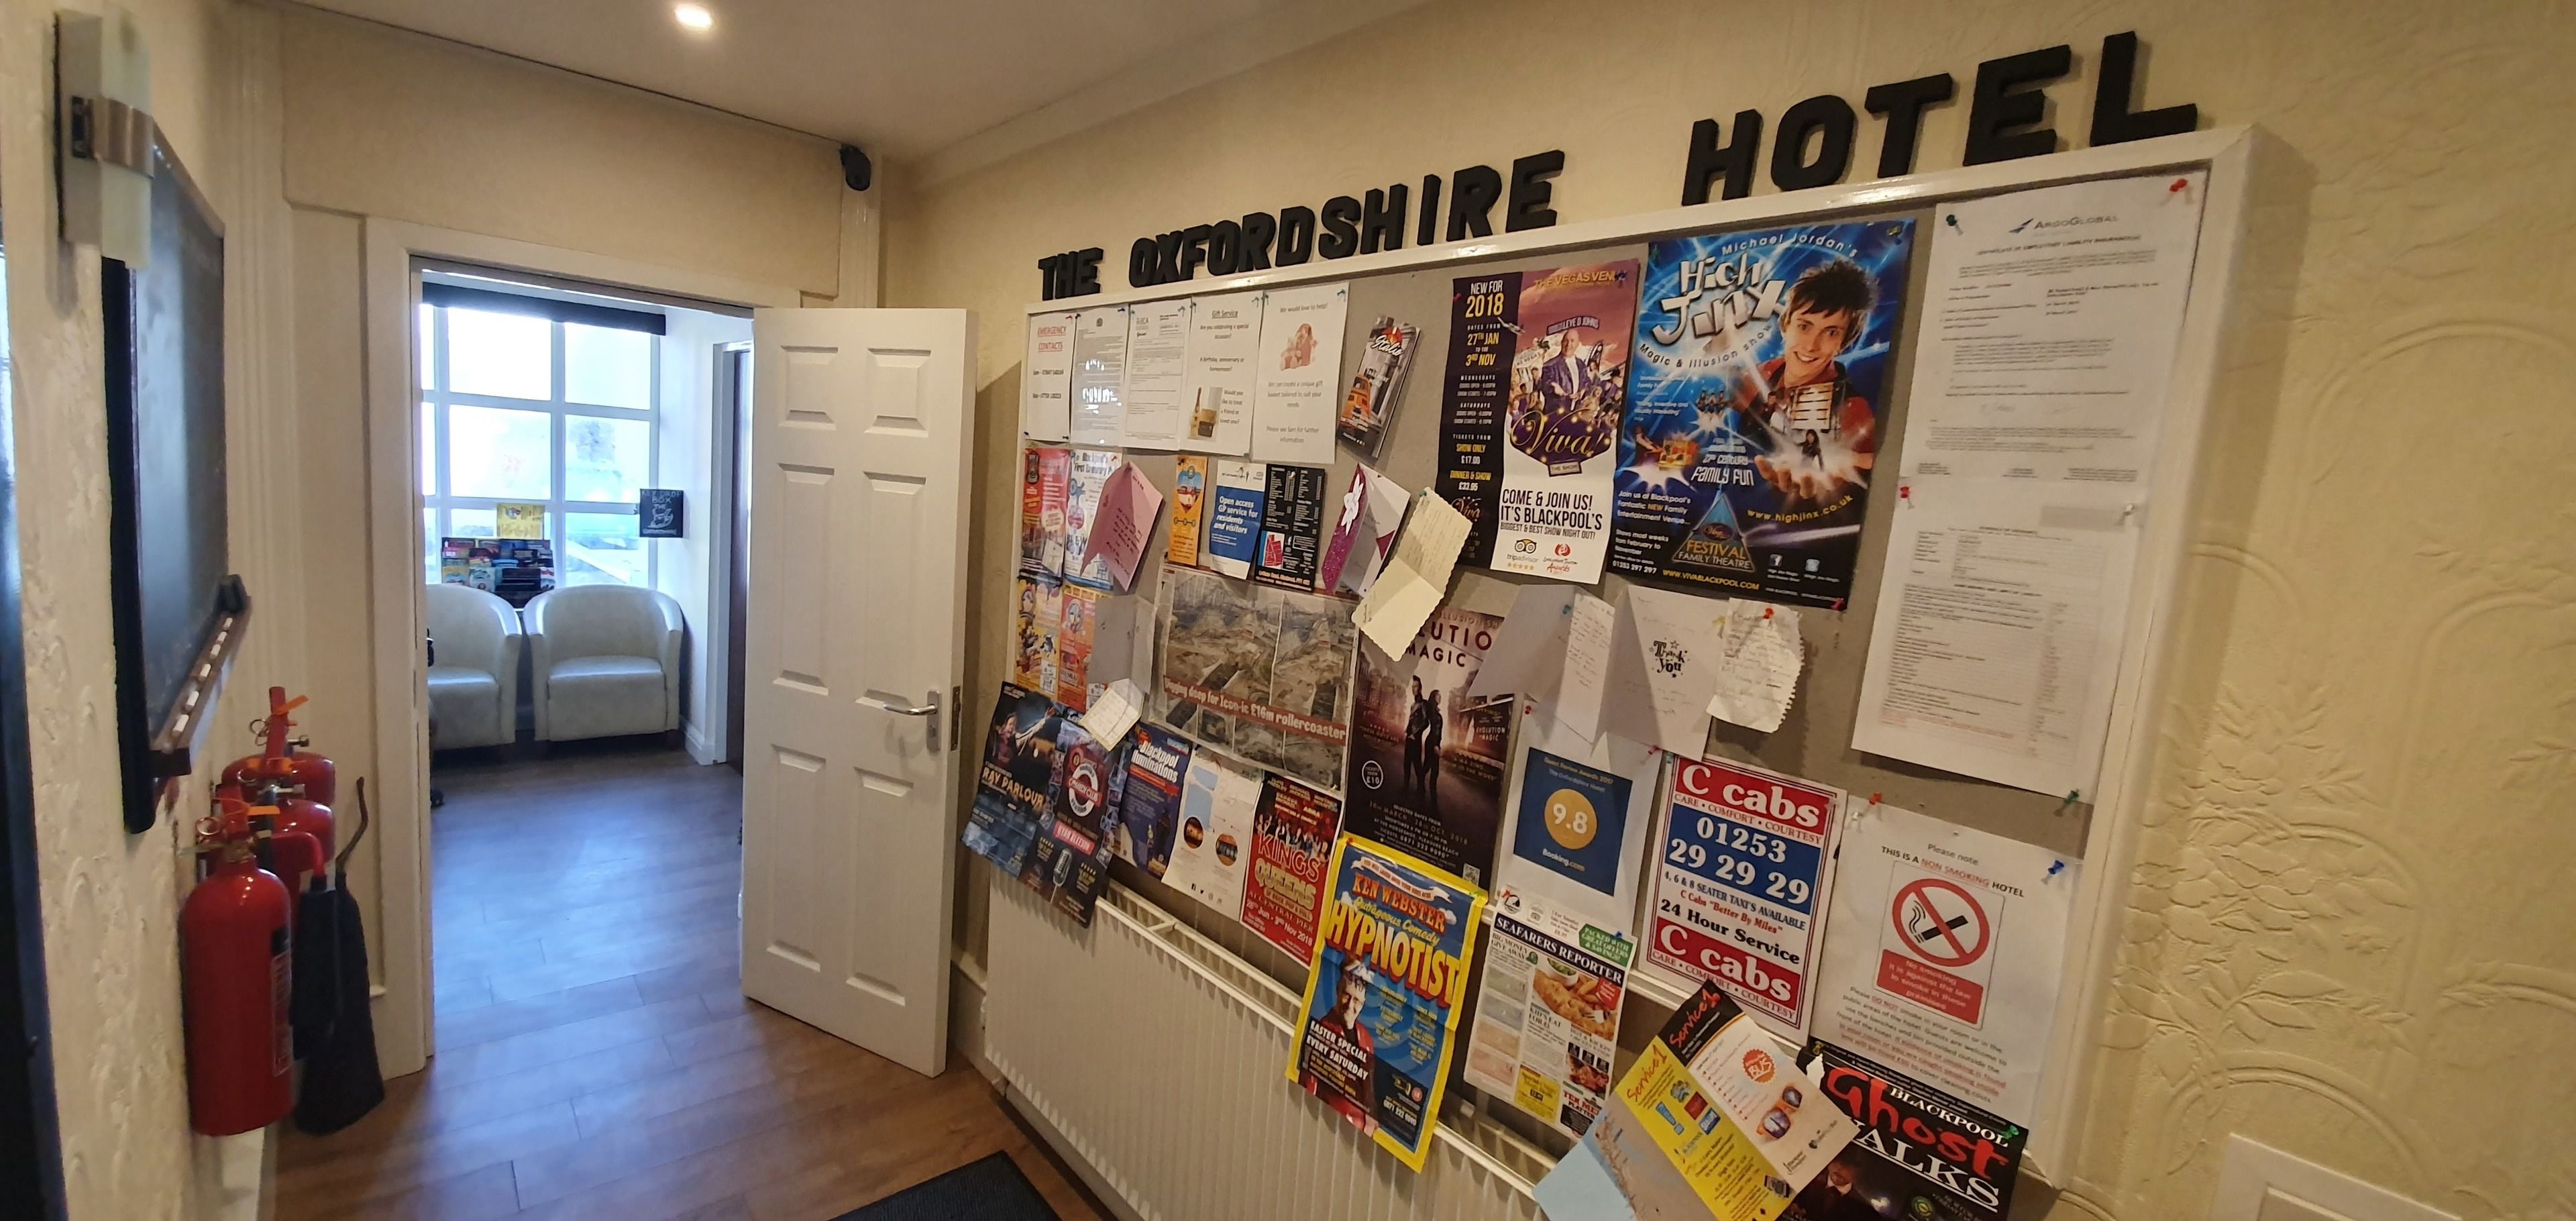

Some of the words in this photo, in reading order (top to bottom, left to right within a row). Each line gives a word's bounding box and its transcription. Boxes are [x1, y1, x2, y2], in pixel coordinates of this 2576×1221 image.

[1038, 247, 1104, 301] THE
[1128, 150, 1566, 288] OXFORDSHIRE
[1681, 30, 2198, 206] HOTEL
[1721, 234, 1783, 256] Michael
[1791, 232, 1859, 258] Jordan's
[1470, 282, 1488, 295] NEW
[1489, 280, 1503, 293] FOR
[1554, 274, 1593, 286] VEGAS
[1465, 293, 1505, 318] 2018
[1484, 332, 1499, 345] JAN
[1478, 354, 1496, 366] NOV
[1639, 343, 1671, 368] Magic
[1219, 496, 1234, 506] Open
[1235, 500, 1254, 509] access
[1227, 507, 1248, 517] service
[1248, 509, 1258, 518] for
[1502, 488, 1533, 505] COME
[1536, 492, 1544, 506] &
[1545, 492, 1571, 509] JOIN
[1572, 494, 1593, 511] US!
[1213, 522, 1225, 530] and
[1225, 523, 1248, 534] visitors
[1216, 514, 1244, 525] residents
[1500, 522, 1523, 533] BIGGEST
[1529, 525, 1543, 535] BEST
[1544, 527, 1562, 536] SHOW
[1562, 528, 1580, 539] NIGHT
[1501, 505, 1521, 522] IT'S
[1523, 510, 1603, 531] BLACKPOOL'S
[1507, 553, 1539, 563] tripadvisor
[1678, 551, 1709, 564] FAMILY
[1712, 555, 1750, 570] THEATRE
[1686, 540, 1747, 560] FESTIVAL
[1405, 641, 1467, 668] MAGIC
[1189, 686, 1206, 704] deep
[1207, 691, 1219, 705] for
[1250, 702, 1275, 722] £16m
[1275, 712, 1346, 740] rollercoaster
[1139, 740, 1179, 769] Blackpool
[982, 766, 1002, 784] RAY
[1002, 778, 1046, 808] PARLOUR
[1366, 776, 1381, 784] £10
[1682, 763, 1711, 795] C
[1722, 782, 1819, 828] cabs
[1552, 802, 1589, 835] 9.8
[1674, 793, 1699, 807] CARE
[1708, 802, 1755, 825] COMFORT
[1765, 820, 1823, 845] COURTESY
[1696, 816, 1787, 863] 01253
[1927, 843, 1955, 859] Please
[1258, 833, 1321, 883] KINGS
[1542, 848, 1585, 871] Booking.com
[1668, 838, 1707, 869] 29
[1715, 853, 1757, 886] 29
[1765, 871, 1810, 905] 29
[1881, 846, 1900, 859] THIS
[1902, 852, 1911, 861] IS
[1912, 855, 1920, 863] A
[1921, 858, 1943, 871] NON
[1945, 865, 1990, 887] SMOKING
[1992, 882, 2025, 898] HOTEL
[1254, 857, 1317, 910] QUEENS
[1352, 873, 1380, 900] KEN
[1381, 885, 1447, 933] WEBSTER
[1673, 873, 1680, 884] 6
[1680, 876, 1688, 886] &
[1689, 878, 1696, 889] 8
[1697, 881, 1727, 902] SEATER
[1758, 904, 1807, 932] AVAILABLE
[1680, 889, 1687, 899] C
[1688, 891, 1707, 908] Cabs
[1741, 913, 1752, 926] By
[1352, 896, 1401, 927] Outrageous
[1402, 917, 1440, 946] Comedy
[1660, 898, 1681, 917] 24
[1687, 908, 1730, 937] Hour
[1733, 926, 1801, 965] Service
[1326, 899, 1461, 1006] HYPNOTIST
[1496, 916, 1558, 953] SEAFARERS
[1558, 943, 1622, 984] REPORTER
[1660, 924, 1688, 956] C
[1700, 949, 1792, 1002] cabs
[1652, 949, 1677, 967] CARE
[1741, 988, 1796, 1020] COURTESY
[1306, 1034, 1330, 1055] EVERY
[1330, 1049, 1369, 1081] SATURDAY
[1337, 1037, 1368, 1063] SPECIAL
[1747, 1057, 1773, 1078] BUS
[1827, 1067, 2010, 1181] Ghost
[1889, 1086, 2010, 1148] BLACKPOOL
[1851, 1117, 2000, 1208] ALKS
